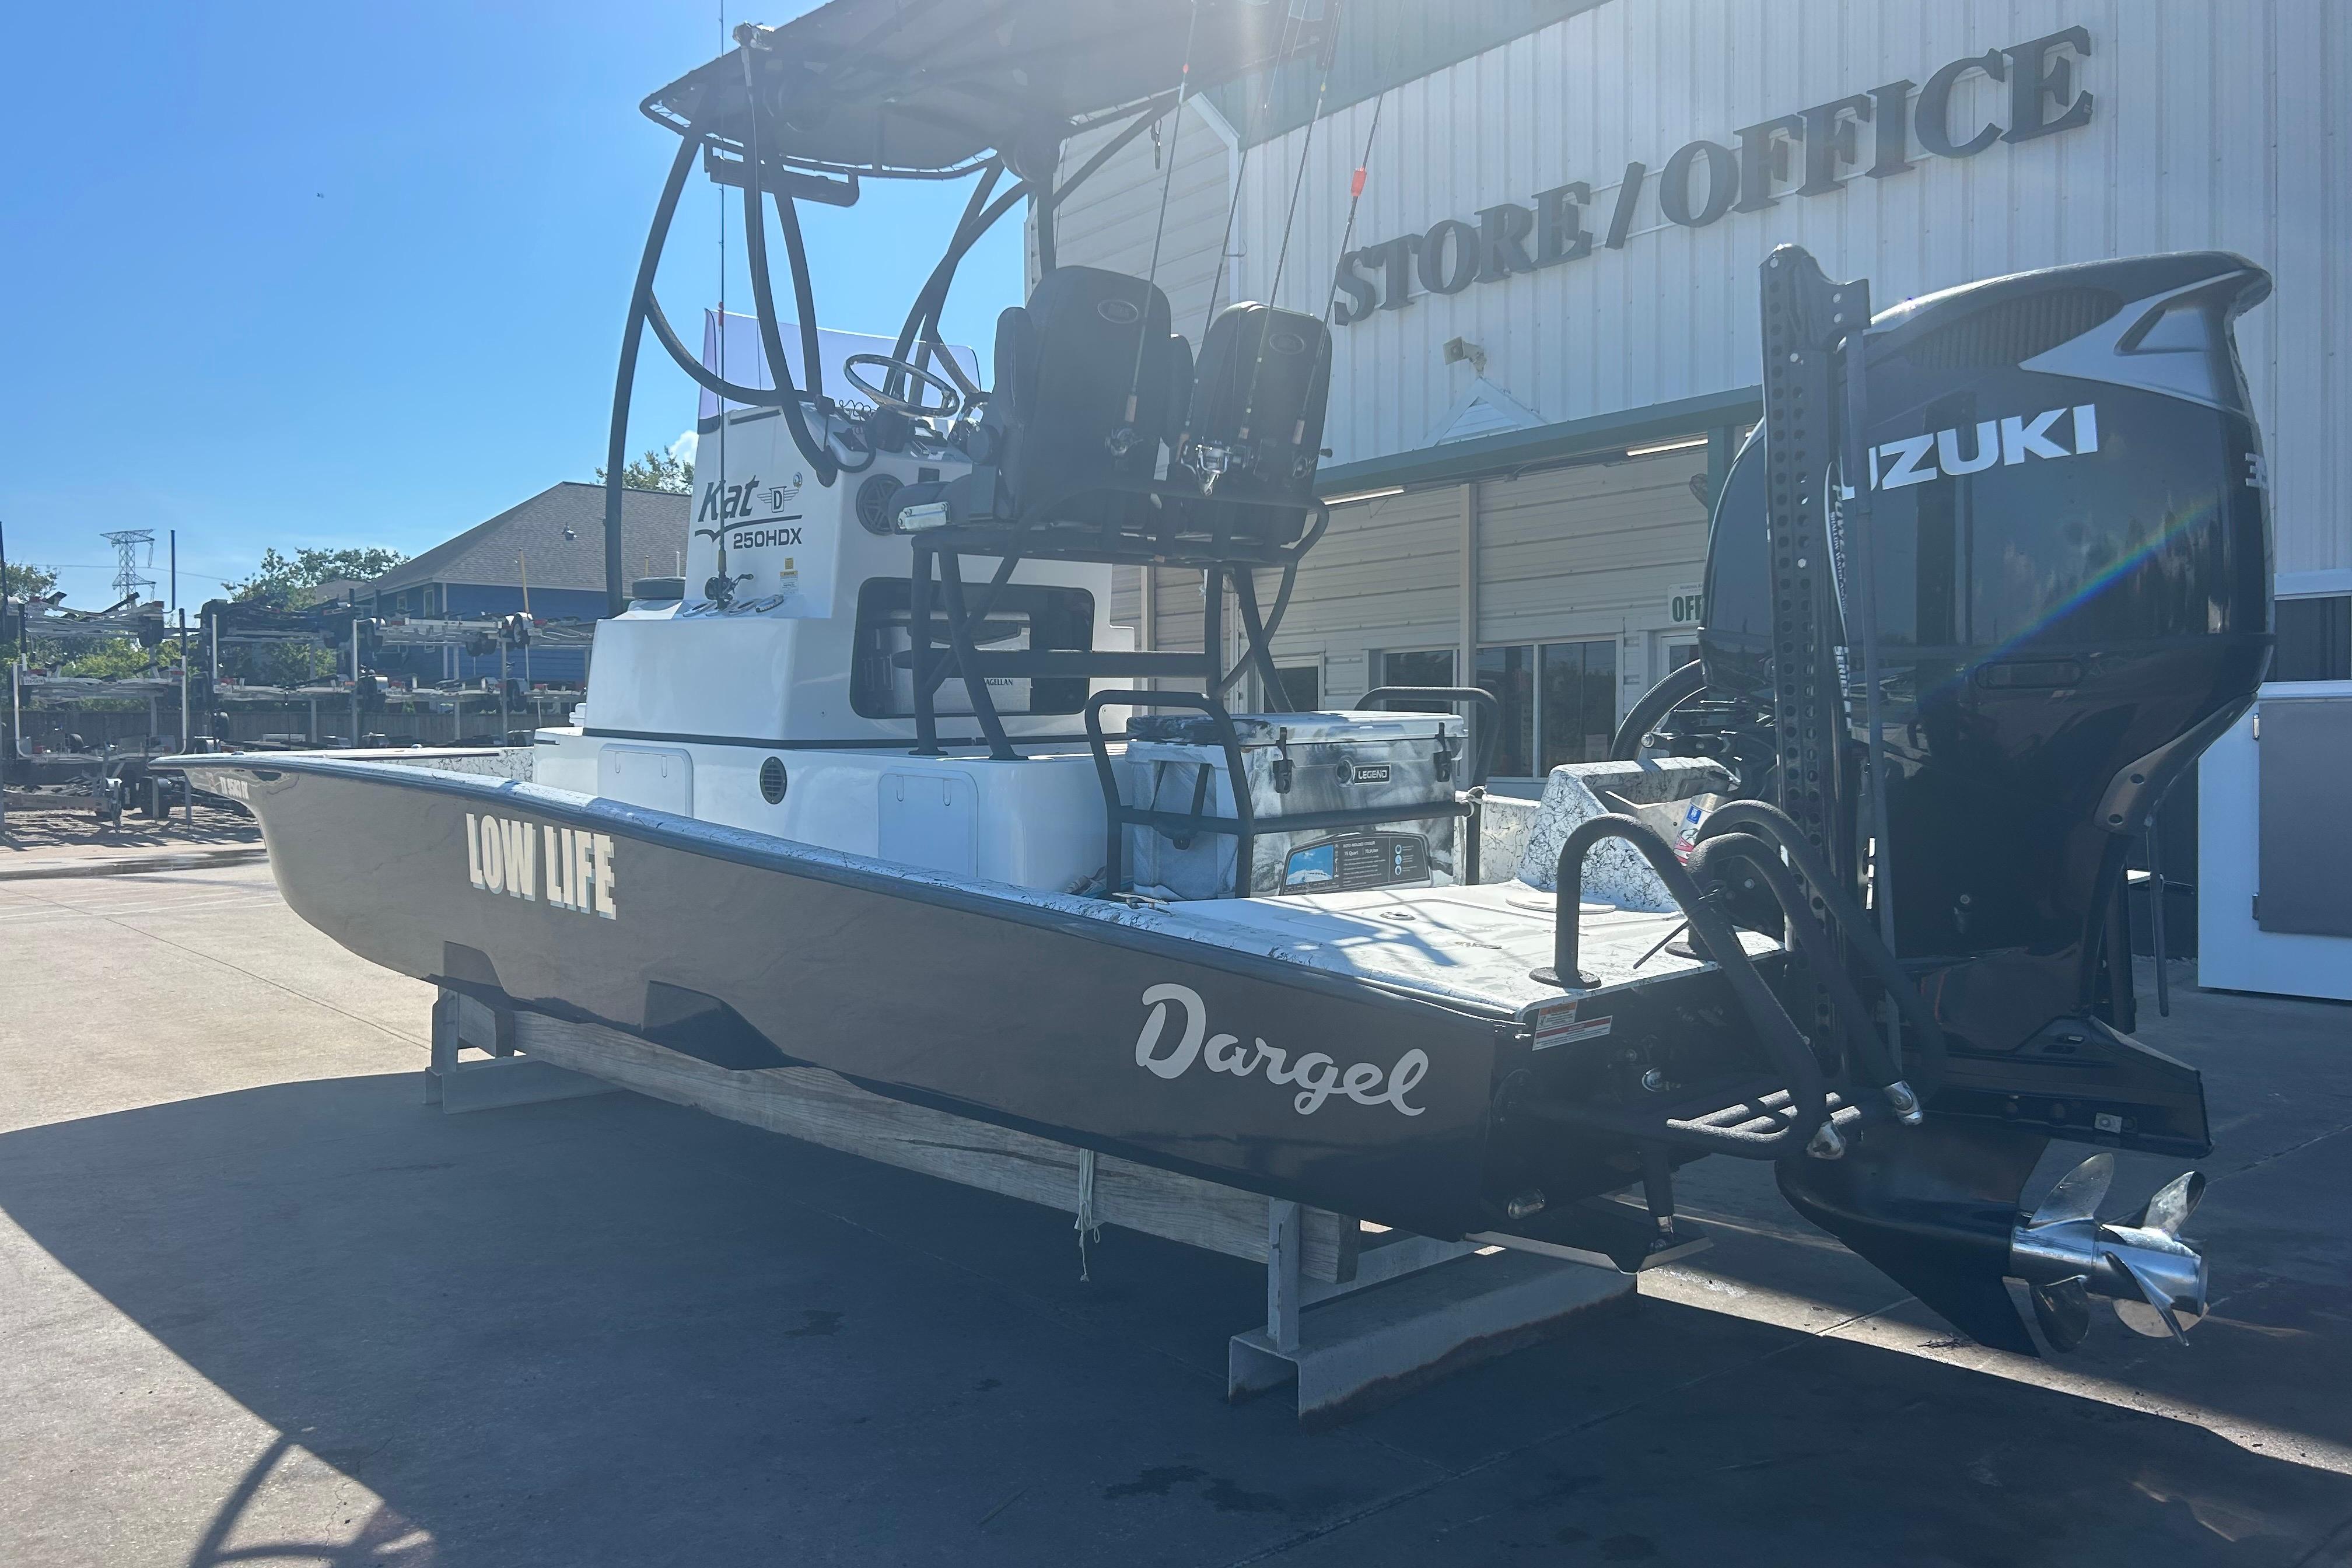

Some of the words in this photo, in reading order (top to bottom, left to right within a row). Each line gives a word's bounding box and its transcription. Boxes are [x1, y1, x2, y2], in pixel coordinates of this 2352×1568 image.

[1842, 404, 2098, 500] ZUKI
[698, 475, 760, 523] Kat
[733, 527, 802, 550] 250HDX
[1672, 595, 1702, 622] OFF
[1358, 769, 1387, 779] LEGEND
[466, 813, 536, 902] LOW
[544, 825, 617, 921] LIFE
[1135, 983, 1429, 1116] Dargel
